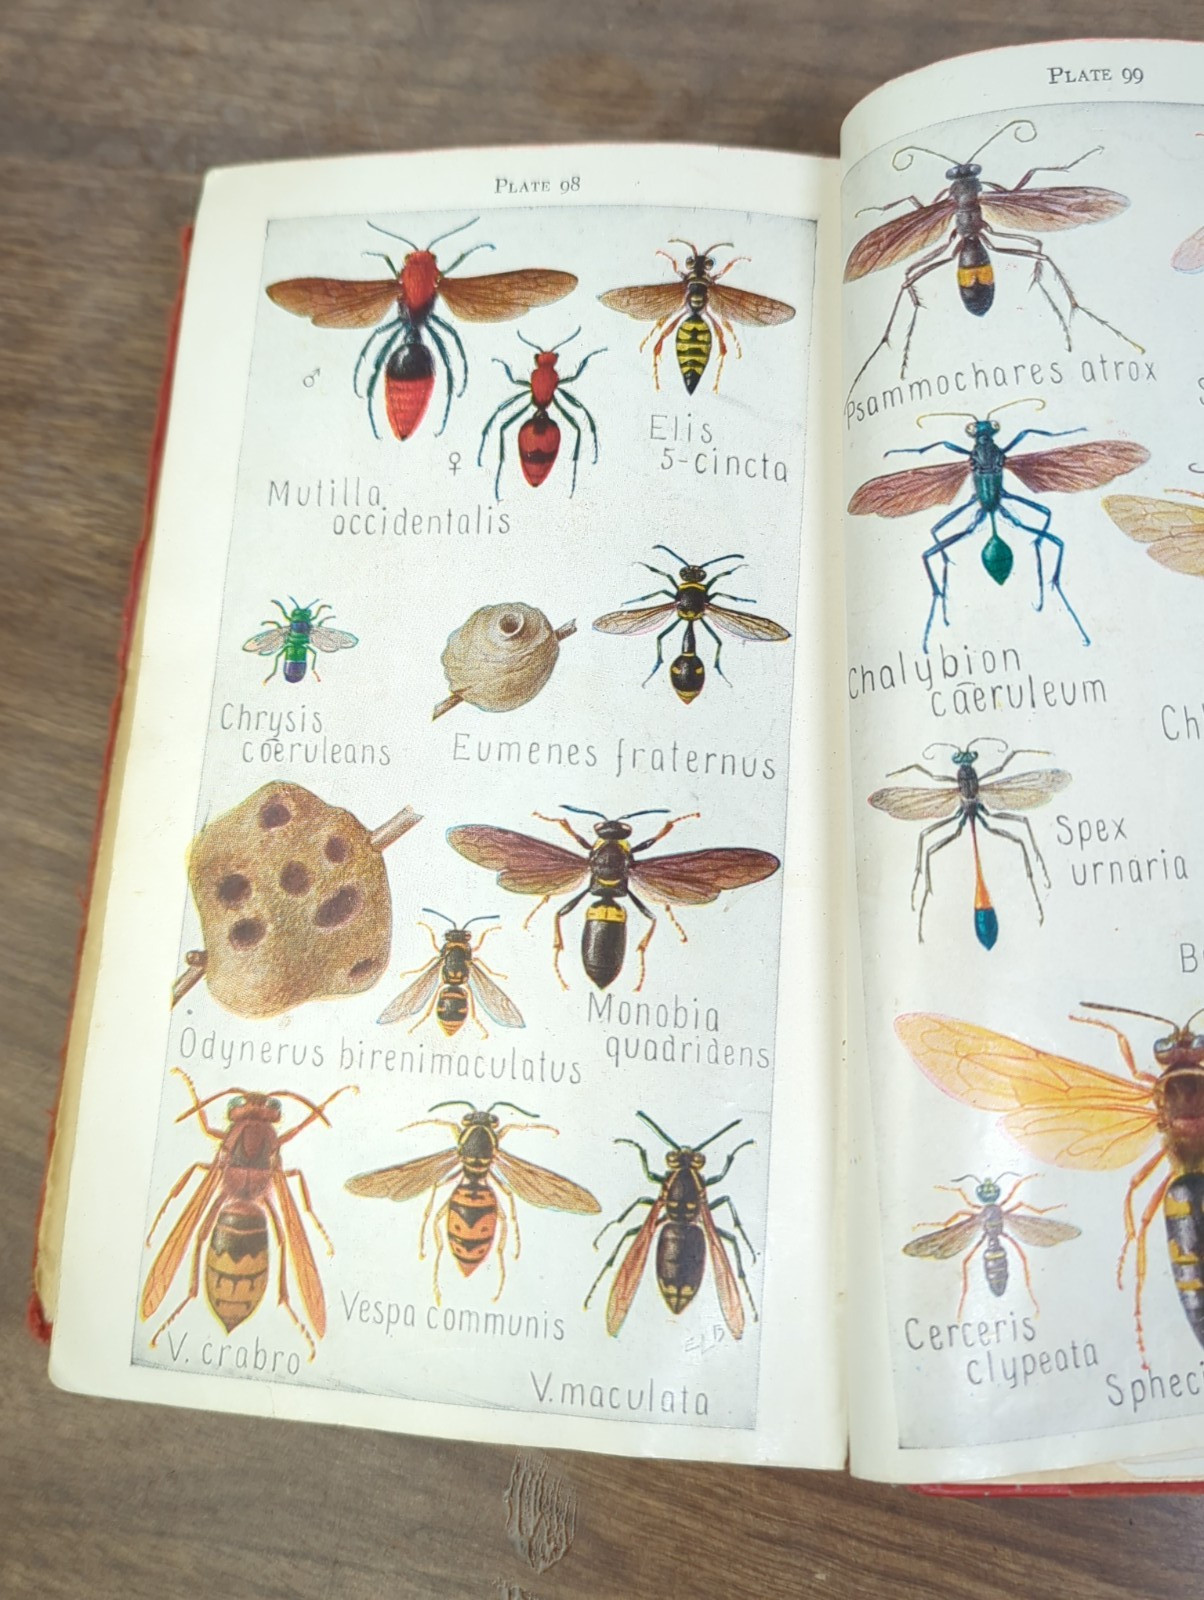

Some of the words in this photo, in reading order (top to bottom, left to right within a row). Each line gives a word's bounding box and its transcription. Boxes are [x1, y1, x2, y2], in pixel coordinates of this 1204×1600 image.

[1049, 67, 1112, 84] PLATE
[1121, 67, 1144, 83] 99
[494, 178, 551, 194] PLATE
[560, 176, 580, 195] 98
[844, 353, 1064, 429] Psammochares
[1081, 353, 1157, 383] atrox
[650, 413, 713, 444] Elis
[661, 447, 788, 482] 5-cincta
[268, 480, 381, 507] Mutilla
[333, 503, 510, 536] occidentalis
[849, 645, 1021, 700] Chalybion
[221, 702, 322, 737] Chrysis
[453, 733, 597, 768] Eumenes
[616, 738, 776, 780] fraternus
[1056, 815, 1128, 851] Spex
[1071, 849, 1189, 886] urnaria
[1180, 942, 1204, 974] B
[587, 992, 720, 1032] Monobia
[179, 1027, 325, 1069] Odynerus
[340, 1036, 582, 1085] birenimaculatus
[605, 1034, 770, 1069] quadridens
[341, 1290, 416, 1338] Vespa
[427, 1301, 565, 1341] communis
[904, 1311, 1036, 1350] Cerceris
[168, 1331, 189, 1363] V.
[201, 1336, 300, 1375] crabro
[966, 1340, 1099, 1388] clypeata
